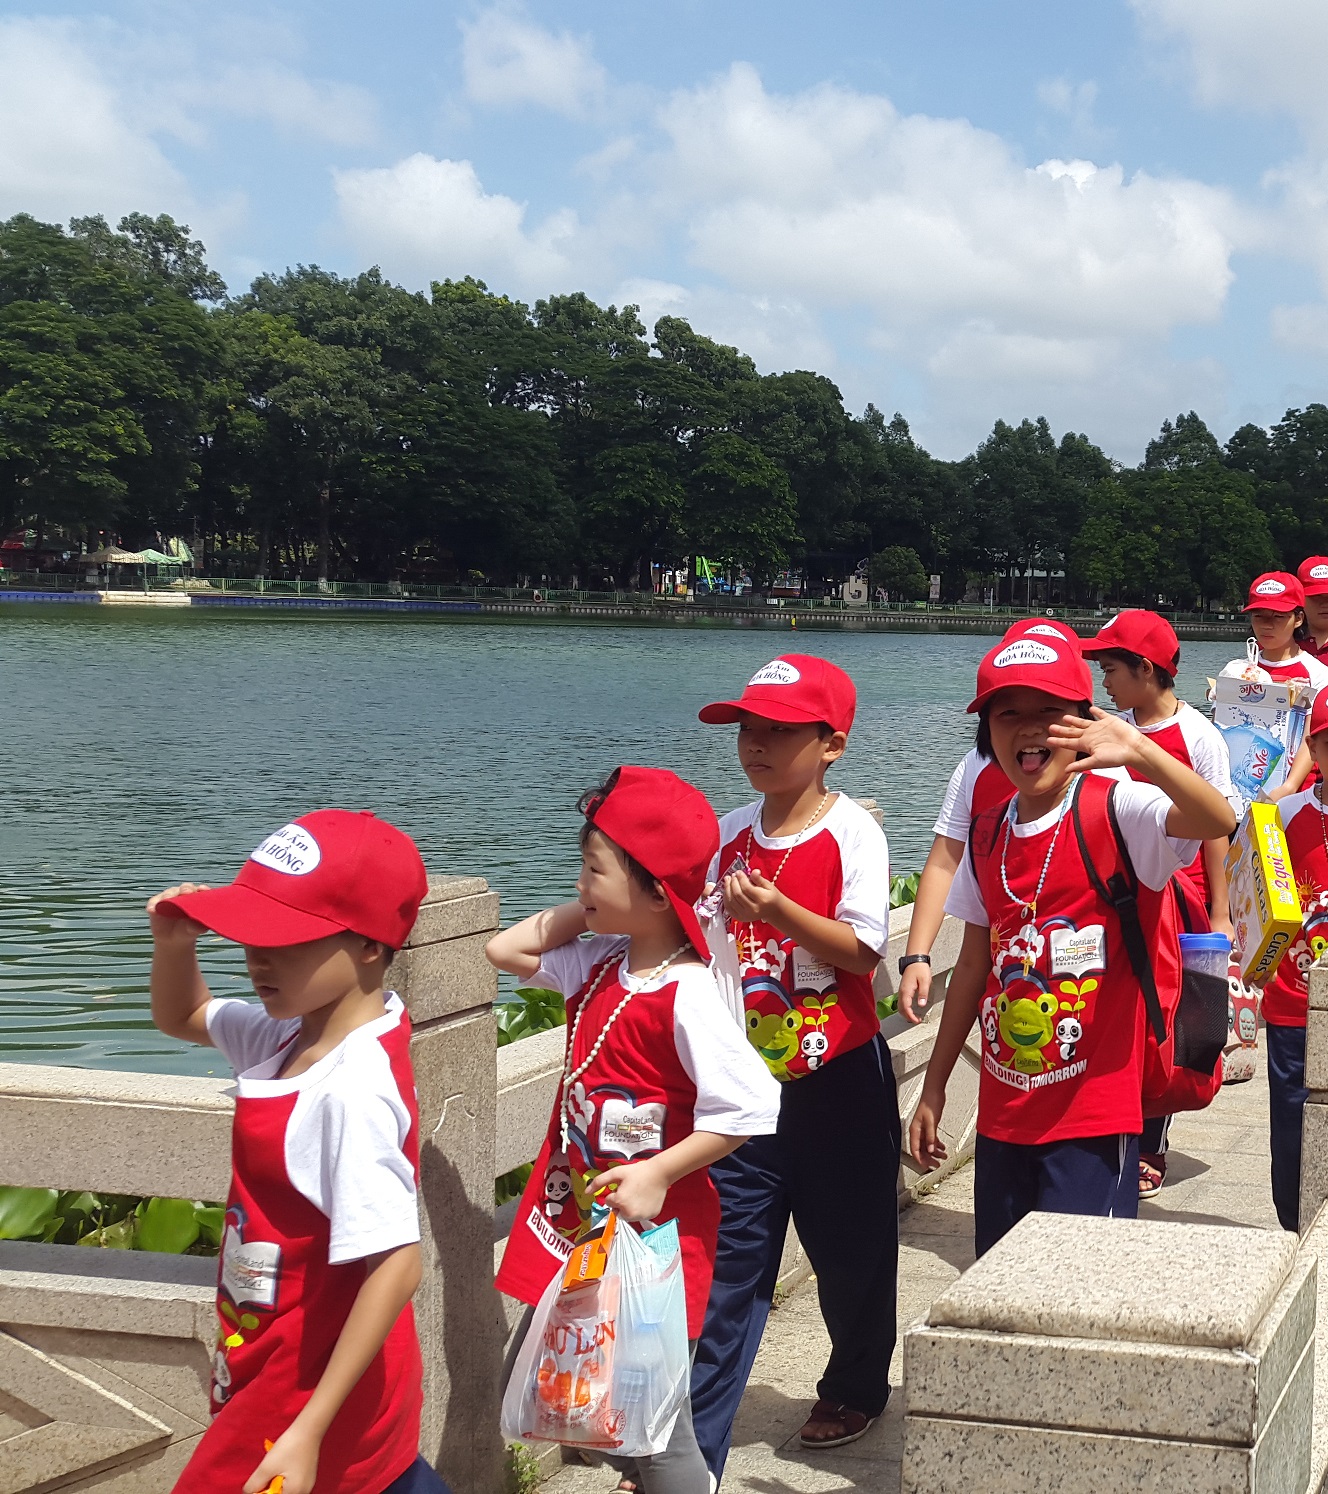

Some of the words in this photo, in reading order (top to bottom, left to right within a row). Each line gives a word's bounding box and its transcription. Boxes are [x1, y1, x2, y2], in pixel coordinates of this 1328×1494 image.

[998, 653, 1017, 665] HOA
[265, 844, 305, 872] HỒNG
[1251, 850, 1268, 923] Custas
[1274, 879, 1290, 890] 2
[1255, 931, 1290, 973] Custas
[1030, 1058, 1088, 1090] TOMORROW
